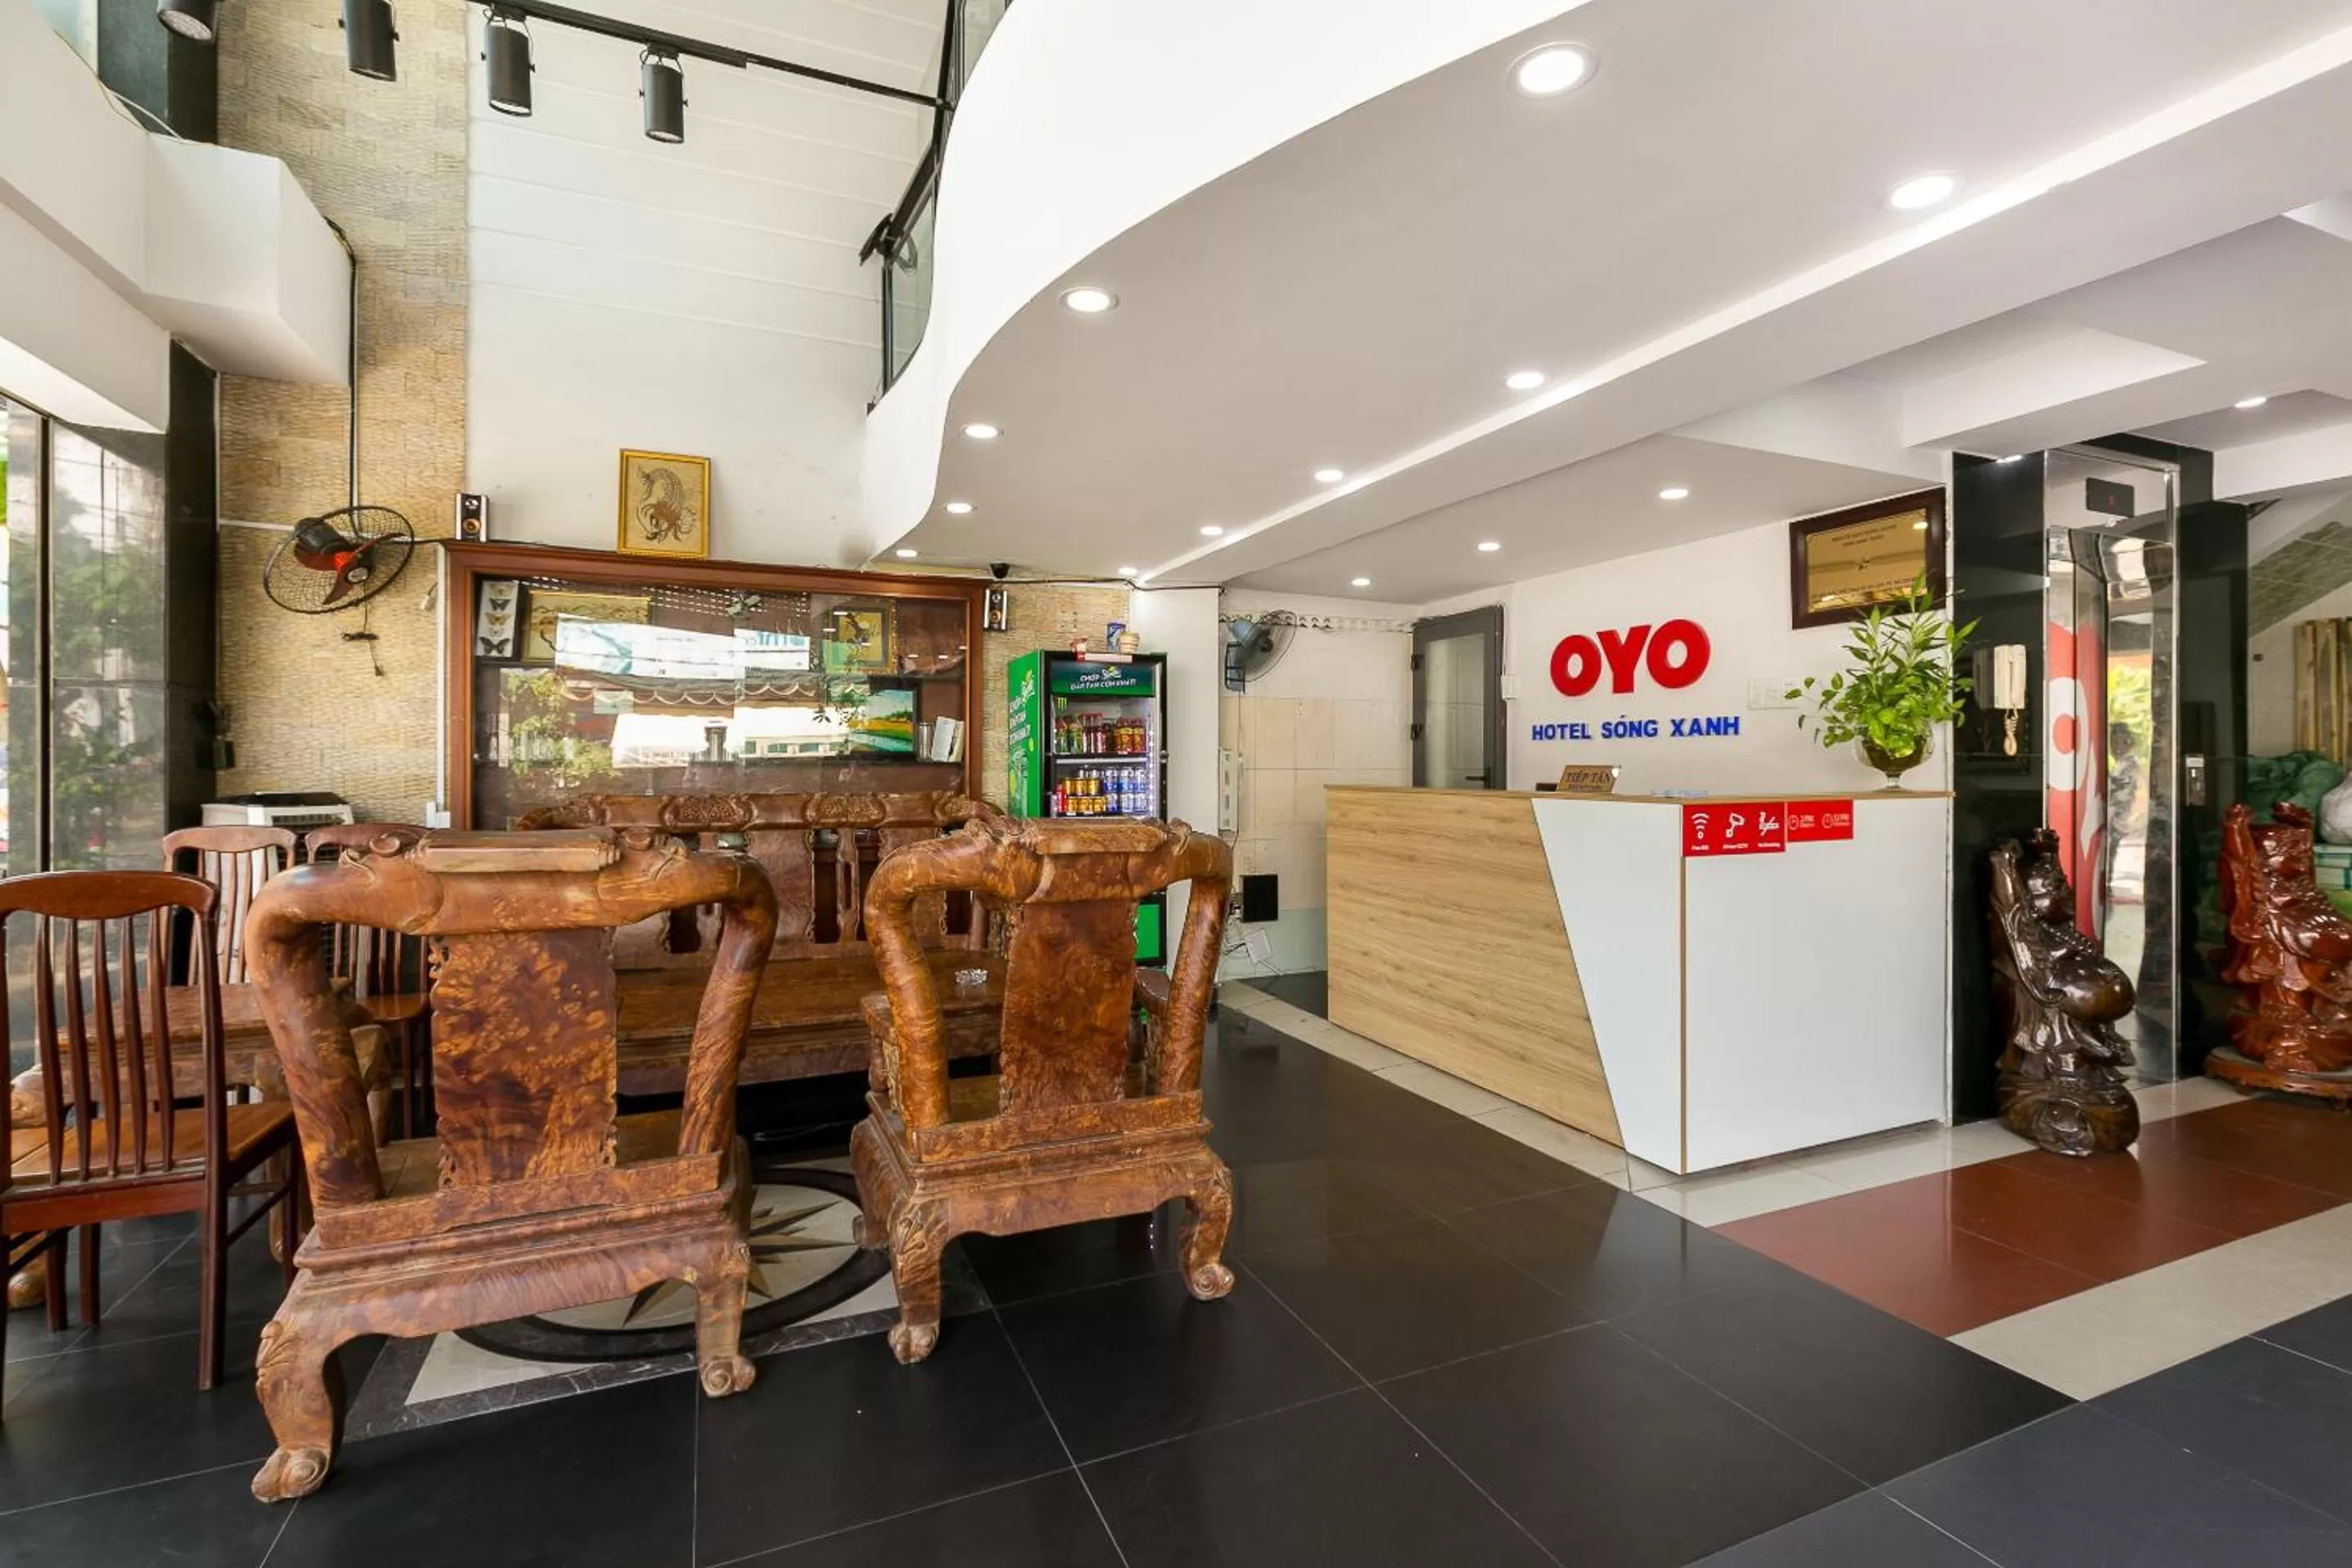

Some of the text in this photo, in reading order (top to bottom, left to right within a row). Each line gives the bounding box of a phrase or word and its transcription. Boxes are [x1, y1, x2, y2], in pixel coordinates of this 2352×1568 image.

[1549, 618, 1712, 697] OYO
[1531, 715, 1740, 740] HOTEL SÓNG XANH
